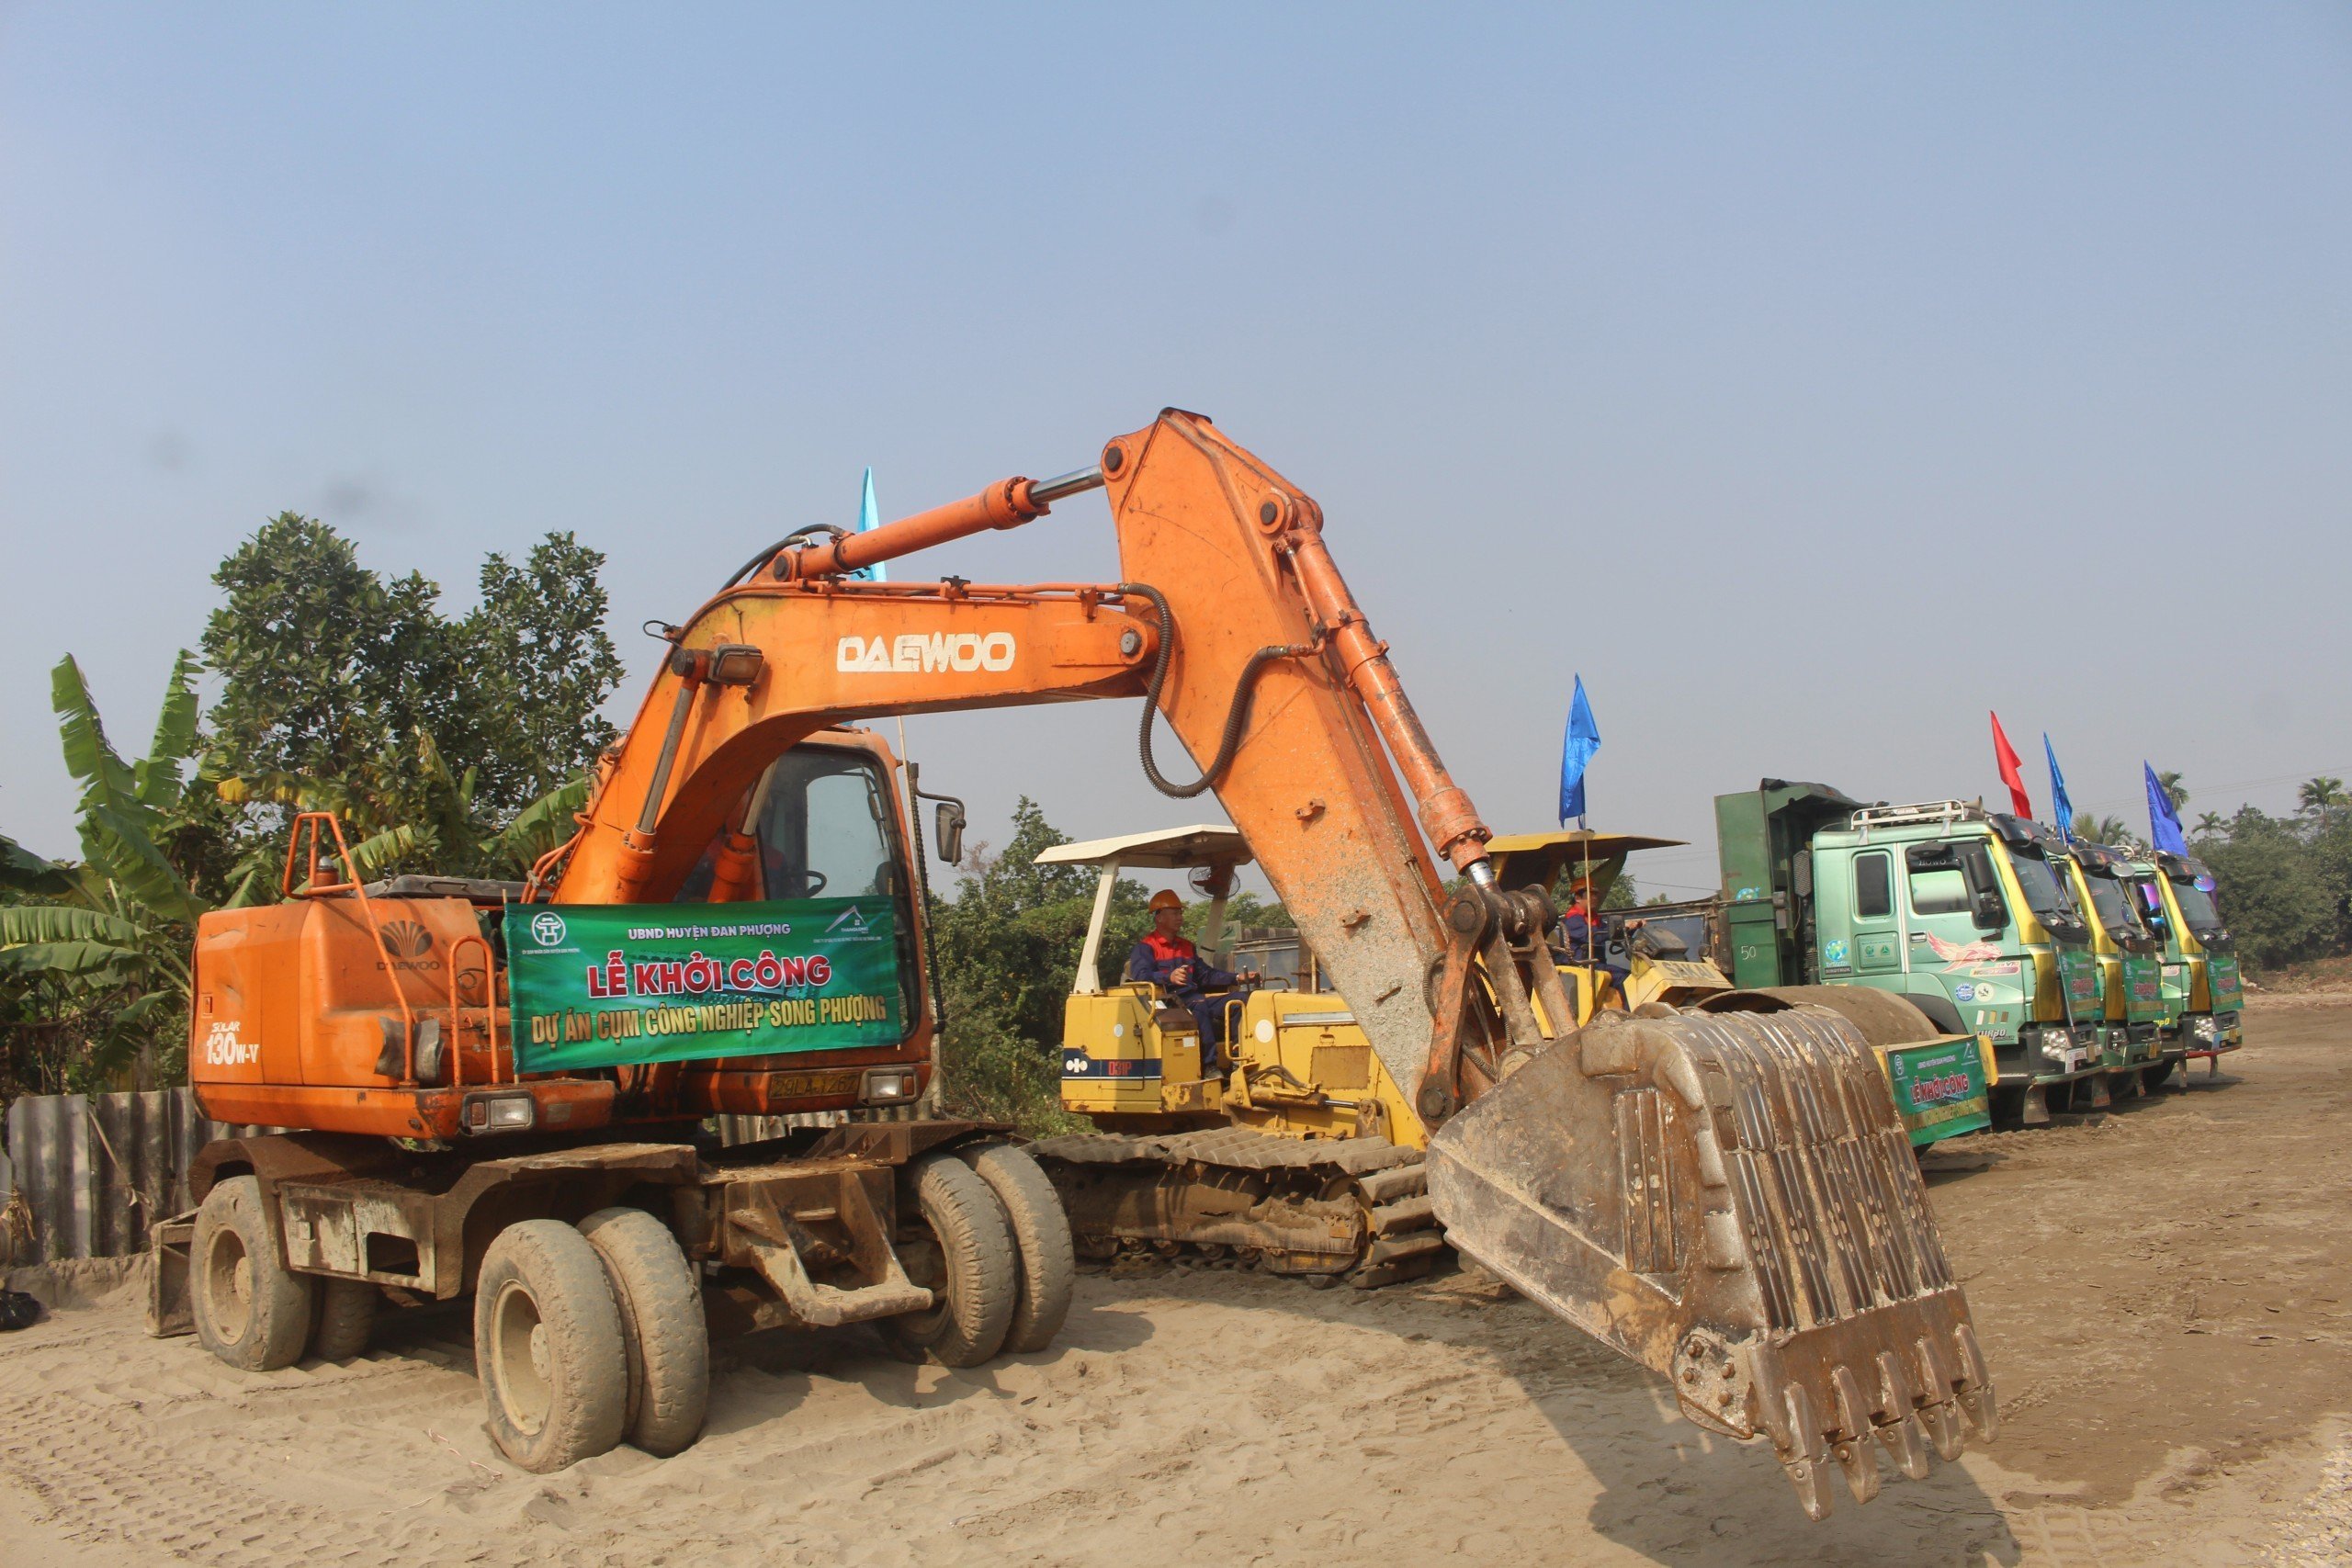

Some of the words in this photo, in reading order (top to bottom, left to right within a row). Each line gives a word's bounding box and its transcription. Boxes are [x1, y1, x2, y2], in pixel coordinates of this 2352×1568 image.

[837, 631, 1016, 673] DAEWOO
[628, 928, 664, 940] UBND
[666, 925, 708, 941] HUYỆN
[710, 925, 738, 937] ĐAN
[739, 923, 791, 939] PHƯỢNG
[1741, 945, 1757, 961] 50
[587, 950, 628, 998] LỄ
[634, 951, 724, 996] KHỞI
[729, 949, 832, 991] CÔNG
[1662, 962, 1715, 978] SAKAI
[211, 1021, 241, 1033] SOLAR
[531, 1011, 560, 1049] DỰ
[564, 1008, 592, 1042] ÁN
[597, 1010, 641, 1044] CỤM
[645, 1002, 696, 1035] CÔNG
[700, 998, 764, 1034] NGHIỆP
[769, 998, 816, 1027] SONG
[820, 994, 887, 1027] PHƯỢNG
[1943, 1070, 1969, 1096] CÔNG
